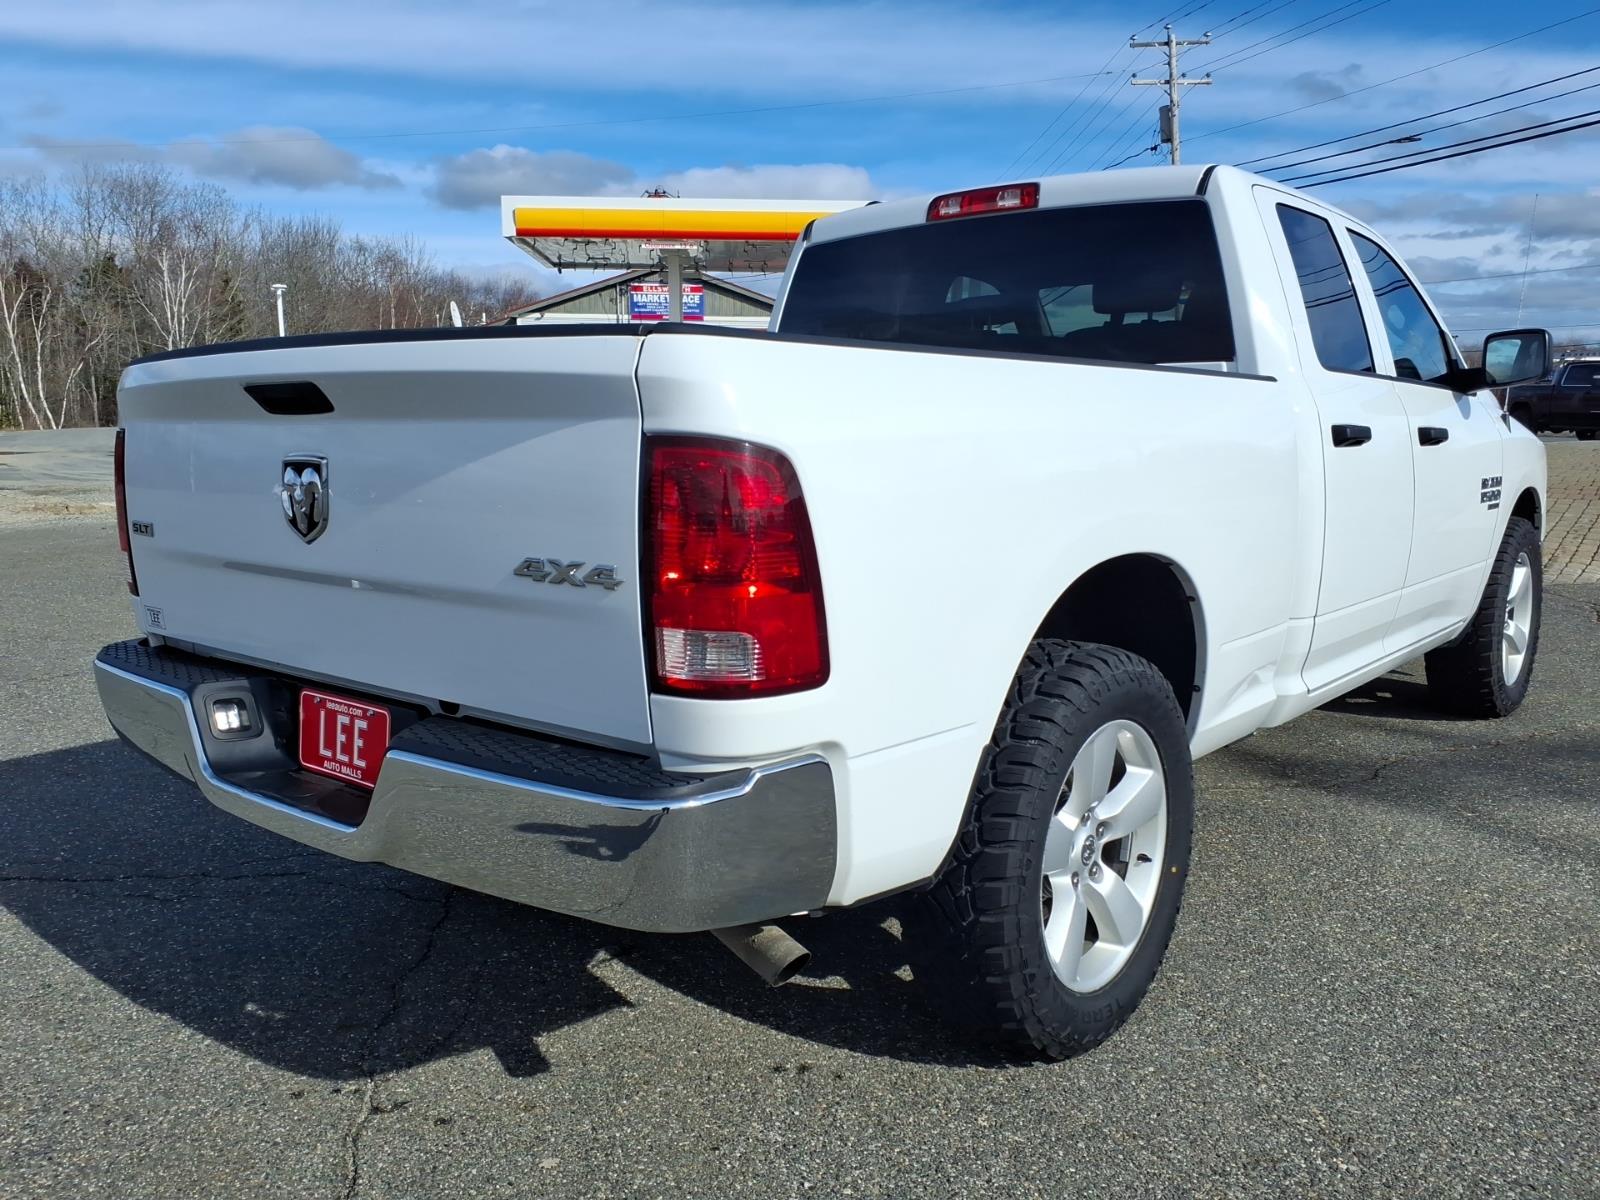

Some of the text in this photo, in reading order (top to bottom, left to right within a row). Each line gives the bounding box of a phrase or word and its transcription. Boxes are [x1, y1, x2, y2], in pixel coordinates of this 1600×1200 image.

[633, 294, 700, 303] MARKETACE
[643, 286, 690, 294] ELLSWH
[133, 523, 150, 534] SLT
[513, 557, 624, 591] 4X4
[326, 700, 363, 717] leeauto.com
[319, 709, 368, 768] LEE
[323, 760, 362, 779] AUTO MALLS
